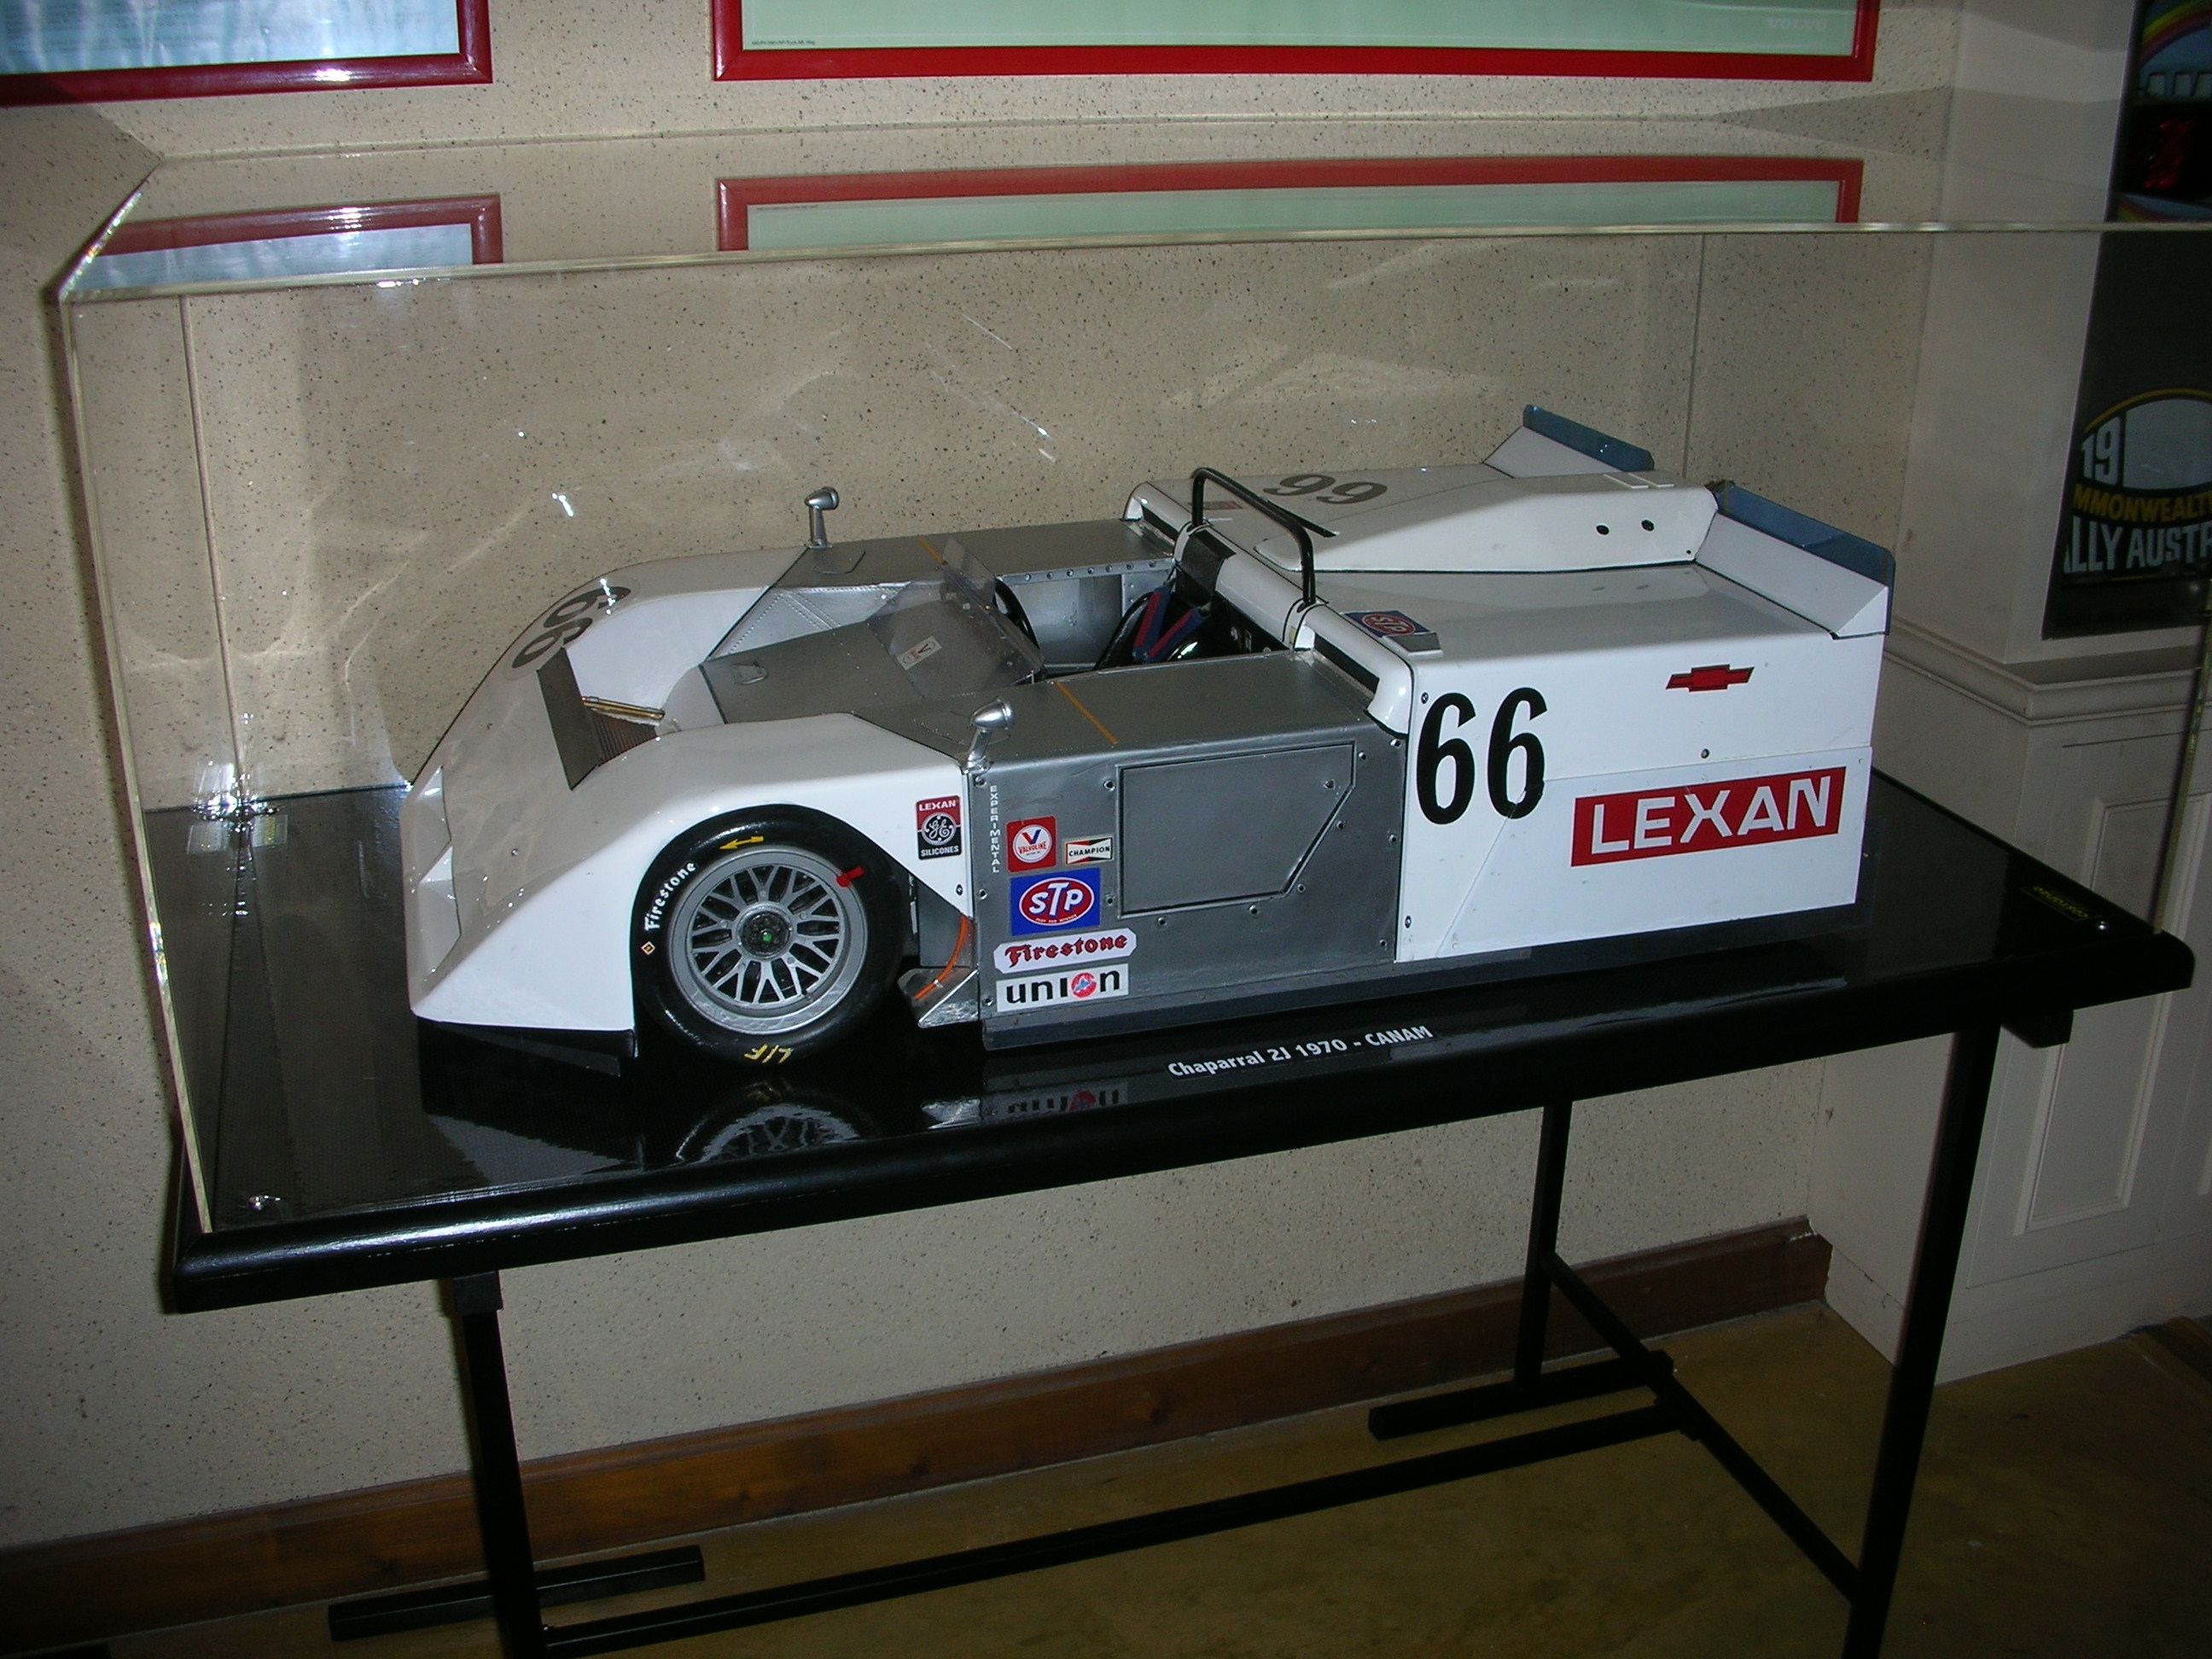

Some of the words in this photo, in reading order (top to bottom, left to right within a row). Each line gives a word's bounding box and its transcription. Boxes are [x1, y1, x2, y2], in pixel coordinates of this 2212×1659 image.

[2081, 416, 2122, 486] 19
[2073, 483, 2212, 522] MMONWEALT
[1370, 614, 1410, 632] STP
[1417, 687, 1547, 825] 66
[918, 800, 957, 811] LEXAN
[1591, 775, 1831, 854] LEXAN
[989, 785, 1001, 873] EXPERIMENTAL
[920, 844, 959, 858] SILICONES
[1018, 841, 1047, 854] VALVOLINE
[1068, 845, 1111, 858] CHAMPION
[644, 860, 698, 933] Firestone
[1028, 882, 1084, 917] STP
[1004, 933, 1128, 969] Firestone
[1005, 969, 1121, 1005] union
[1167, 1050, 1266, 1078] Chaparral
[1270, 1047, 1293, 1062] 2J
[1295, 1039, 1348, 1059] 1970
[1365, 1025, 1435, 1047] CANAM
